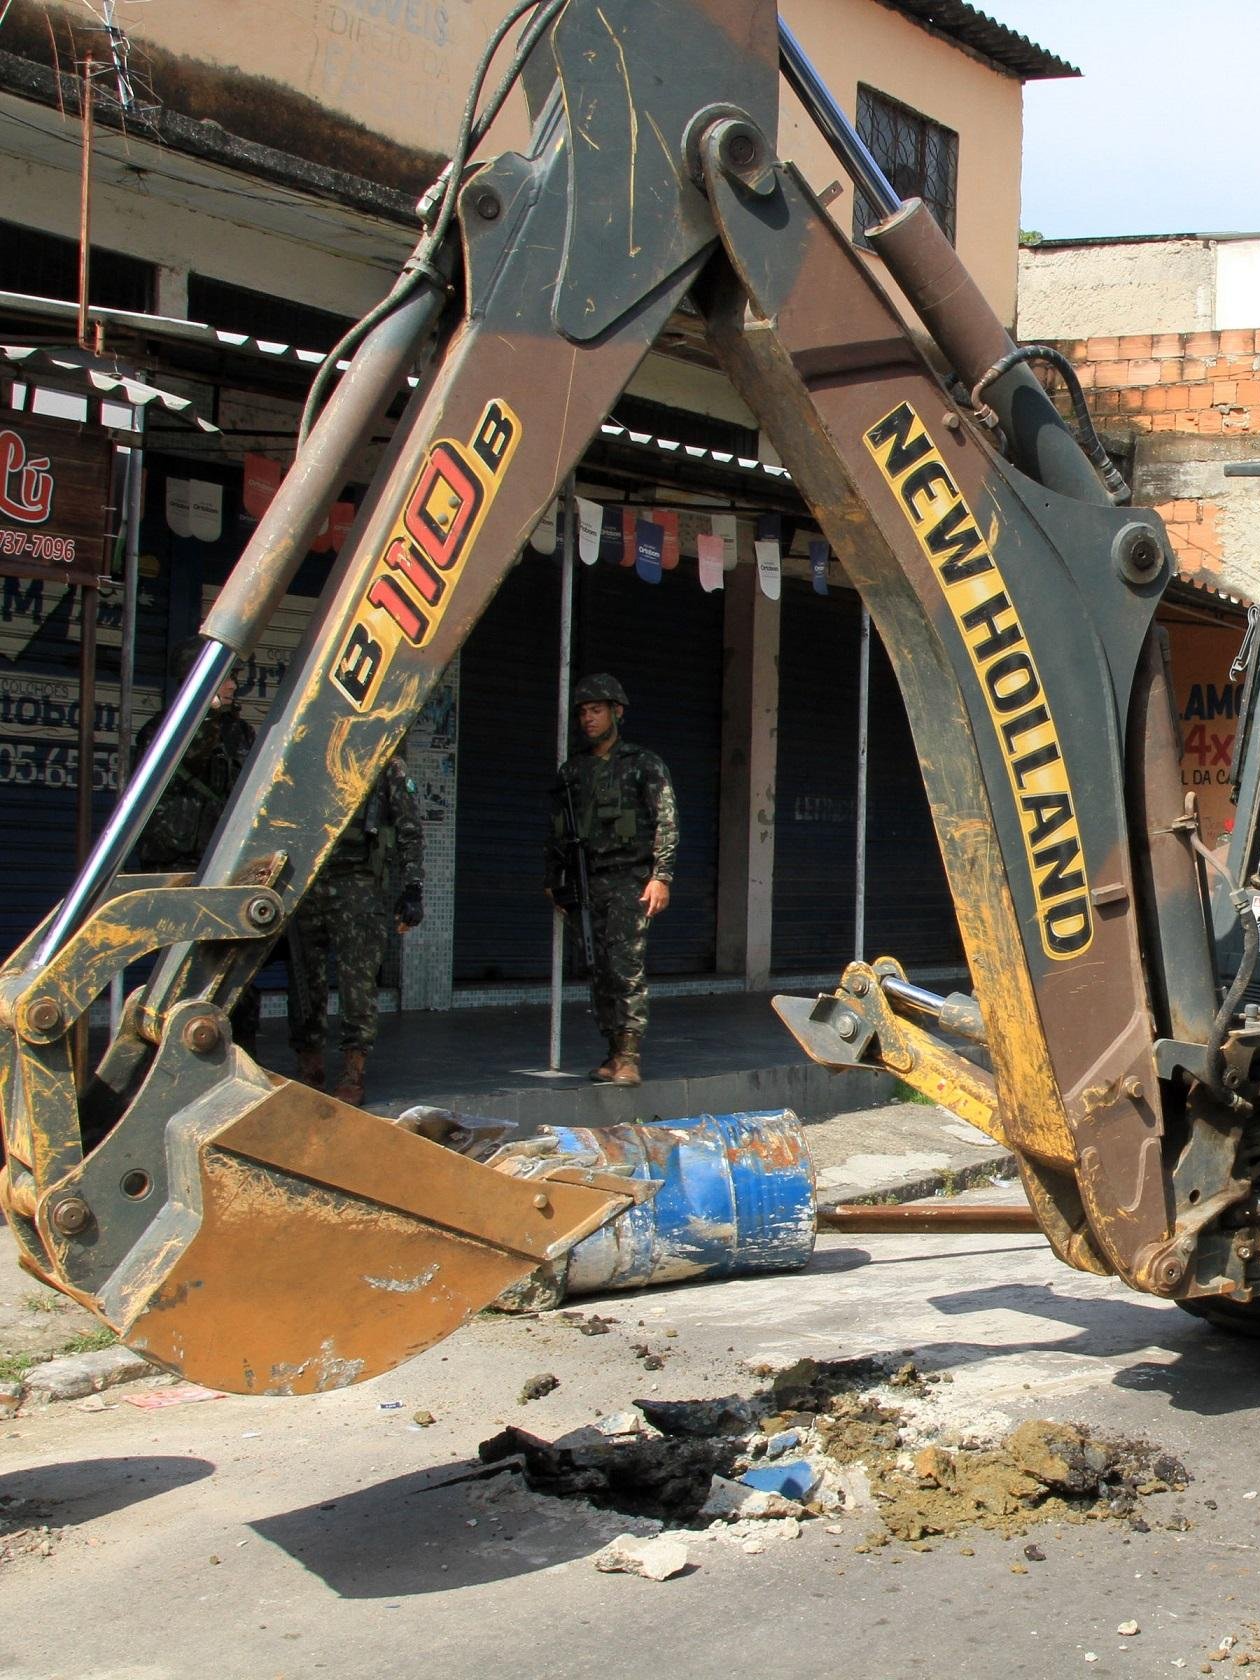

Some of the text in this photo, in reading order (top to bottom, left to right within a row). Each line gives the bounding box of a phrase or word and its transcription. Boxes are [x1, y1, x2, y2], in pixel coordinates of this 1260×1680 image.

[868, 402, 1093, 954] NEW HOLLAND
[1193, 770, 1212, 785] DA
